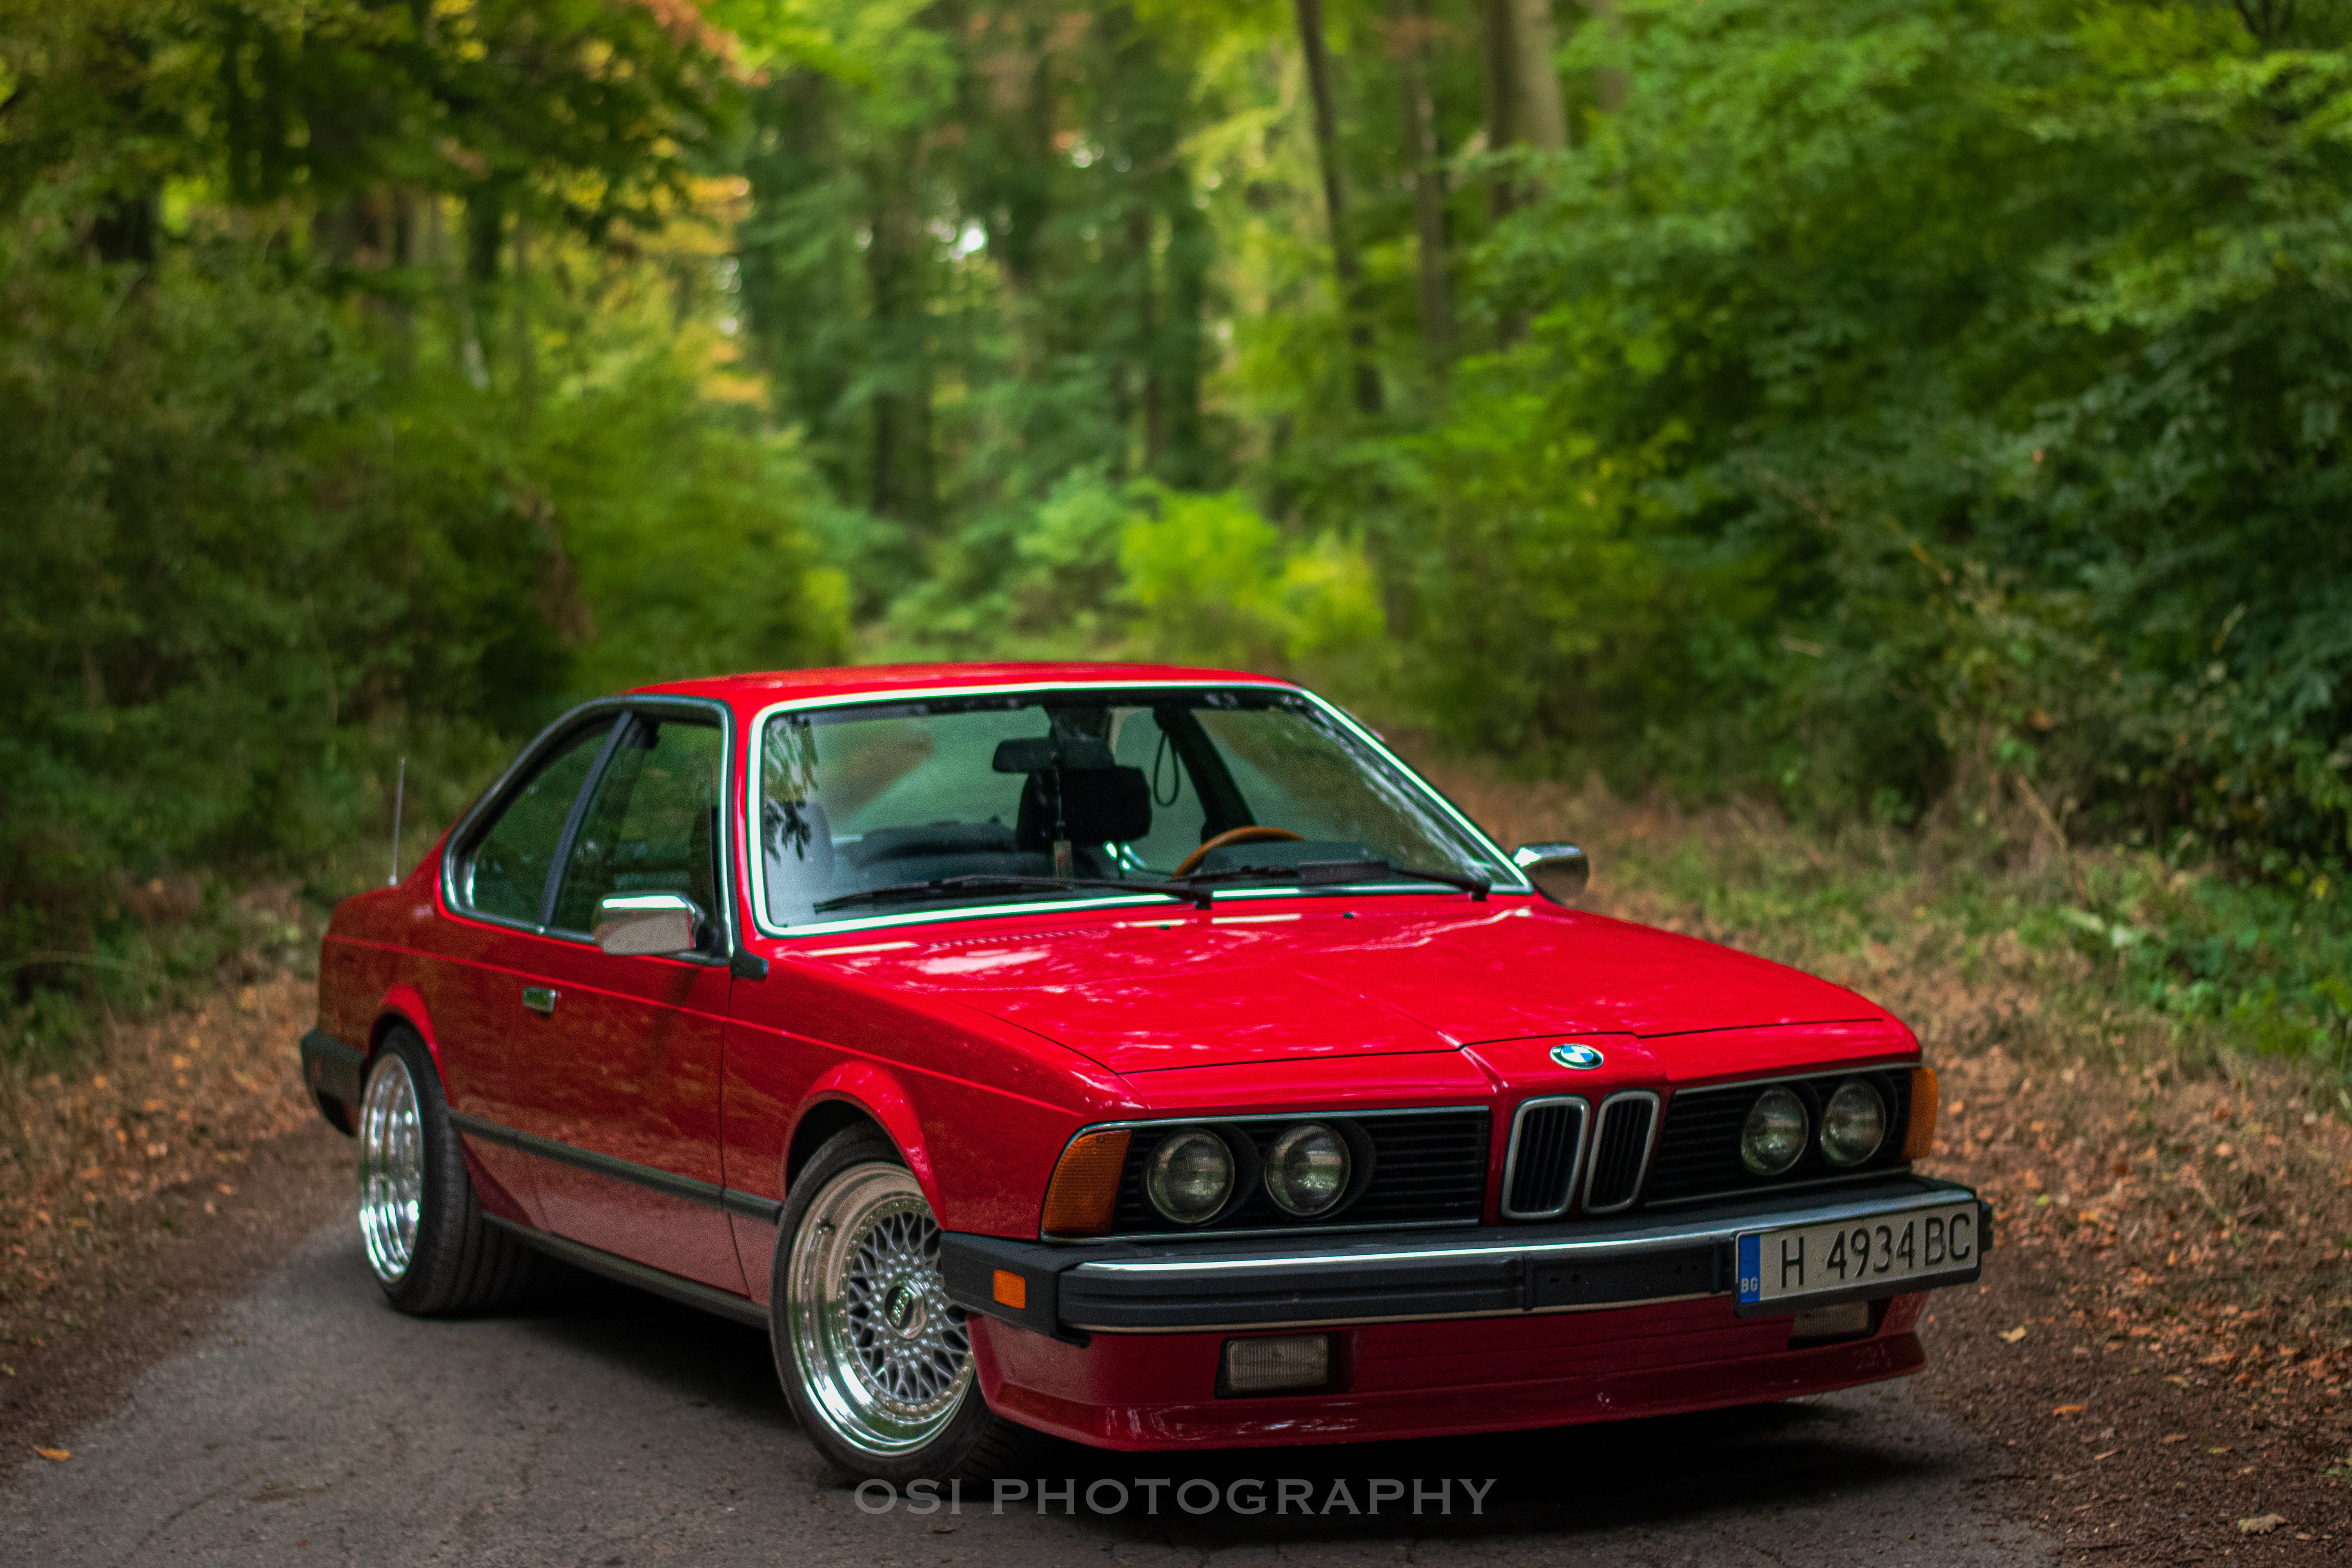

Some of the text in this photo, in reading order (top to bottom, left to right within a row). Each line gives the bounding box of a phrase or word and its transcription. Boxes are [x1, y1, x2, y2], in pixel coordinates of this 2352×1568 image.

[1781, 1213, 1971, 1288] H 4934 BC
[1741, 1277, 1758, 1293] BG
